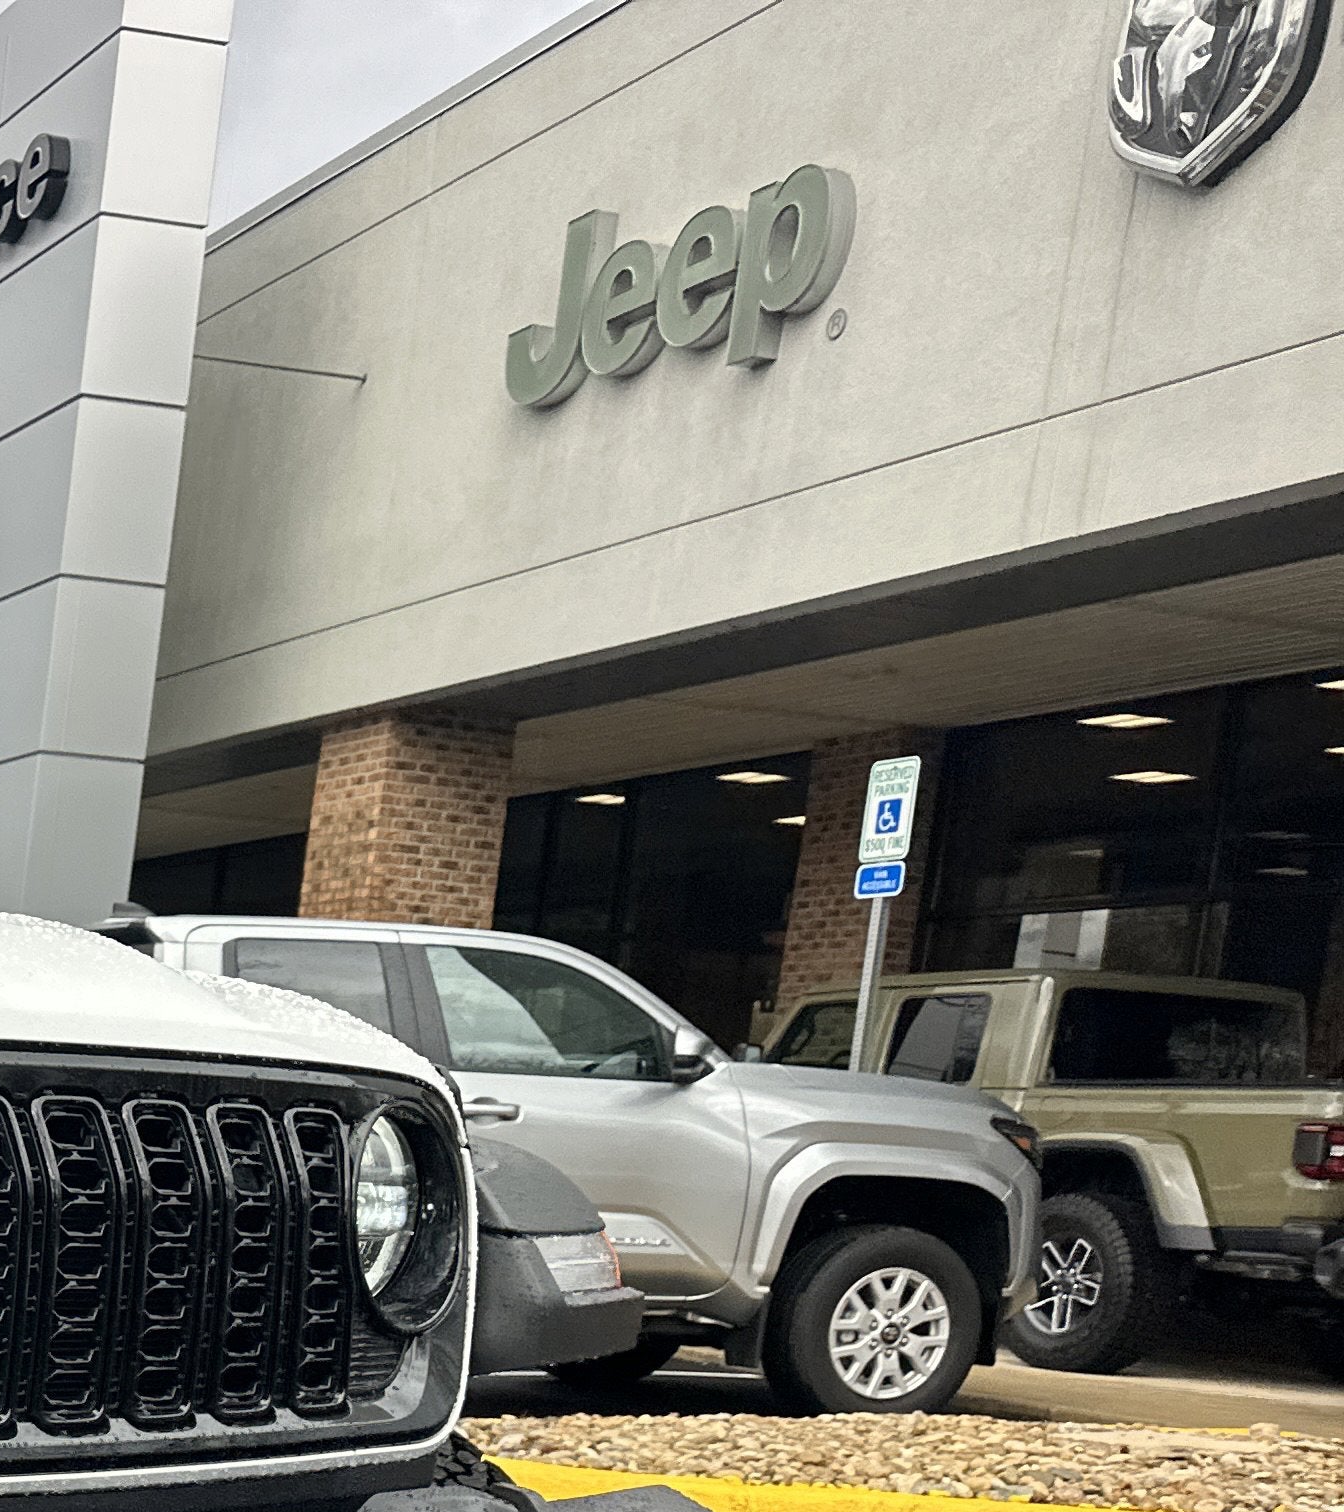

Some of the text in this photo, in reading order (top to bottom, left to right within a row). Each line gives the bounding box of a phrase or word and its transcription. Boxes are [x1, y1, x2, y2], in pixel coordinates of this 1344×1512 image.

[505, 163, 857, 407] Jeep
[875, 766, 914, 781] RESERVED
[875, 782, 910, 796] PARKING
[888, 837, 905, 849] FINE
